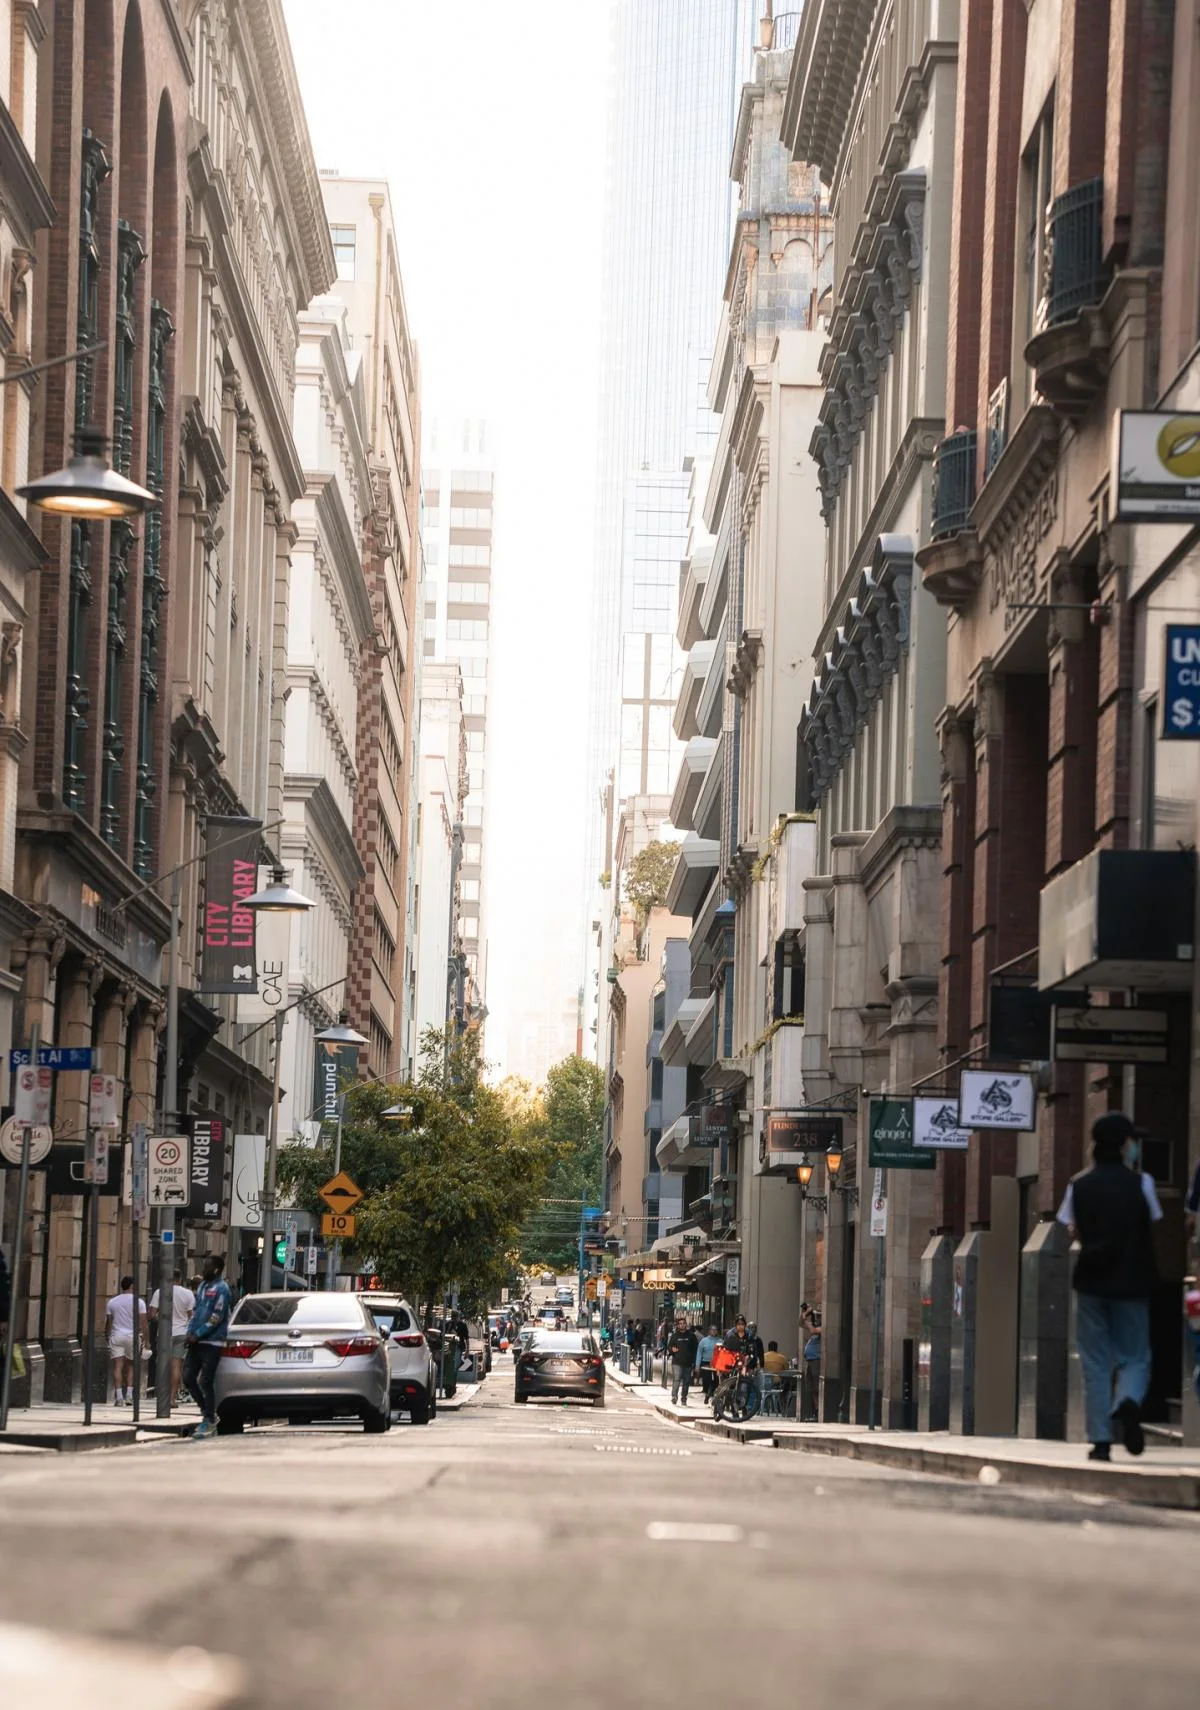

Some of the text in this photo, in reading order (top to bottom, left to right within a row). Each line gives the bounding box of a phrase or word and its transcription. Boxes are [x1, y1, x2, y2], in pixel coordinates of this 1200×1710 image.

[206, 902, 229, 946] CITY
[262, 960, 283, 1005] CAE
[793, 1133, 817, 1147] 238
[161, 1149, 176, 1159] 20
[192, 1120, 211, 1187] LIBRARY
[246, 1192, 260, 1224] CAE
[331, 1217, 346, 1229] 10
[642, 1282, 675, 1291] COLLINS
